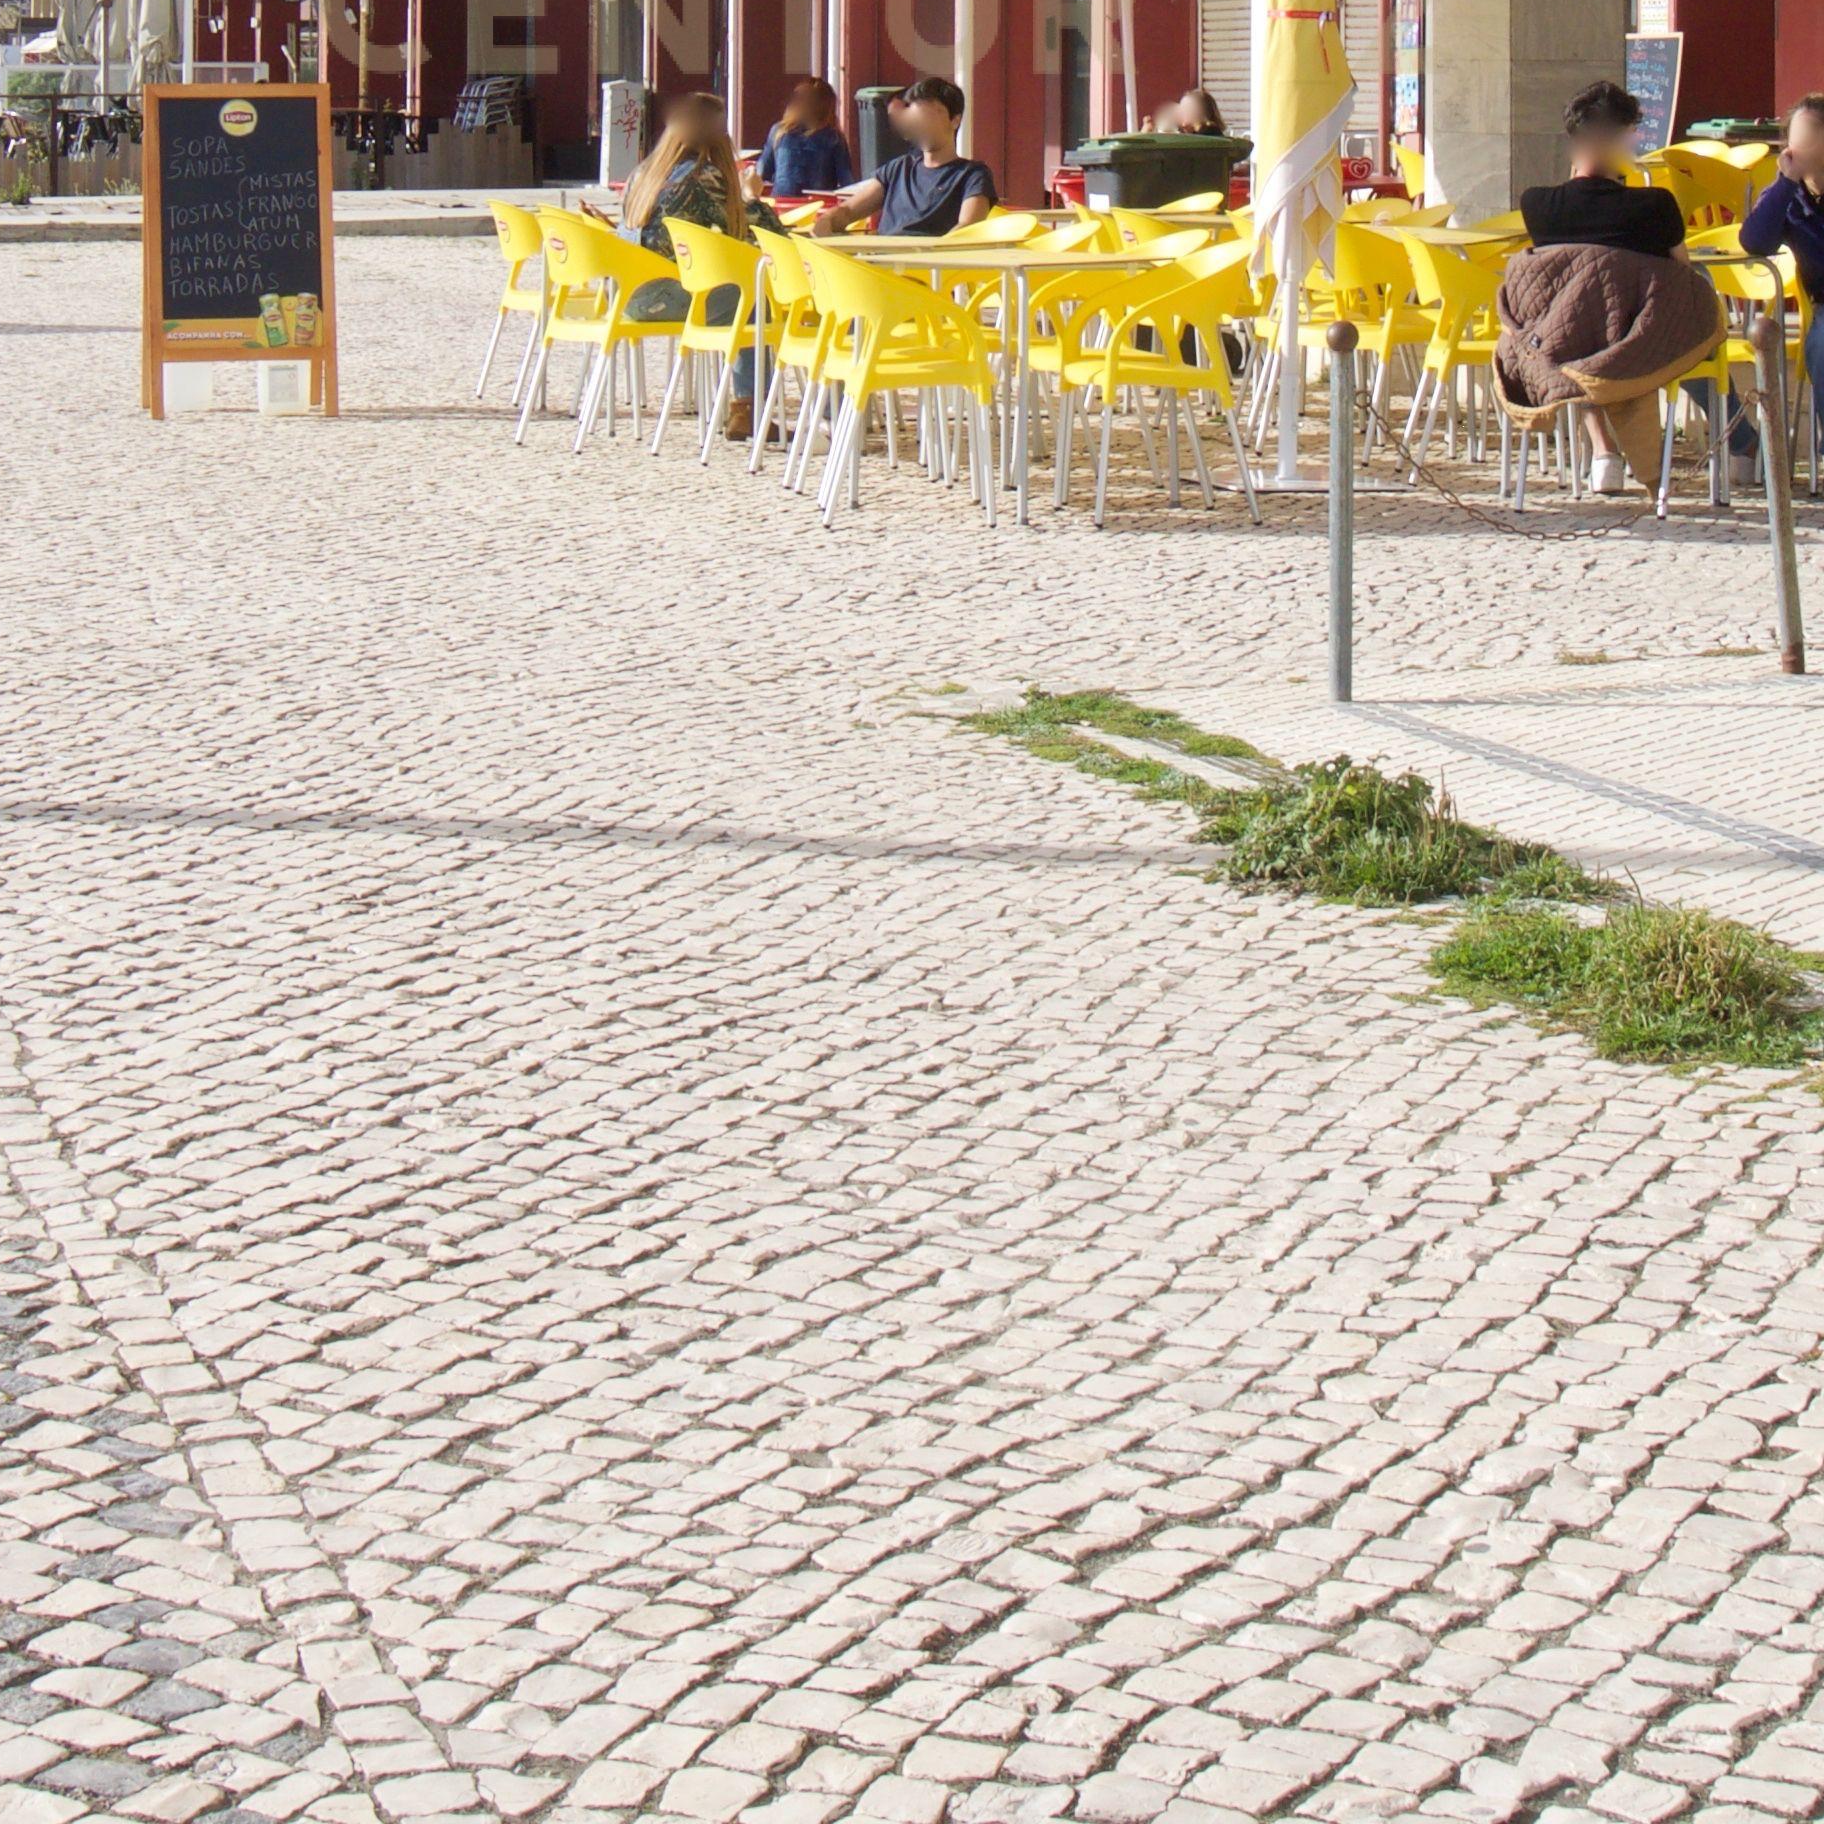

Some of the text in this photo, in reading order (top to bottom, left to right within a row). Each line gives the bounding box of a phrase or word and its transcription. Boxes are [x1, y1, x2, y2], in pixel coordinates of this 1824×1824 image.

[225, 111, 251, 122] Lipton
[171, 136, 229, 157] SOPA
[167, 155, 246, 180] SANDES
[248, 193, 317, 214] FRANGO
[168, 200, 234, 231] TOSTAS
[248, 214, 300, 232] ATUM
[169, 231, 317, 255] HAMBURGUER
[170, 254, 262, 277] BIFANAS
[167, 273, 280, 299] TORRADAS
